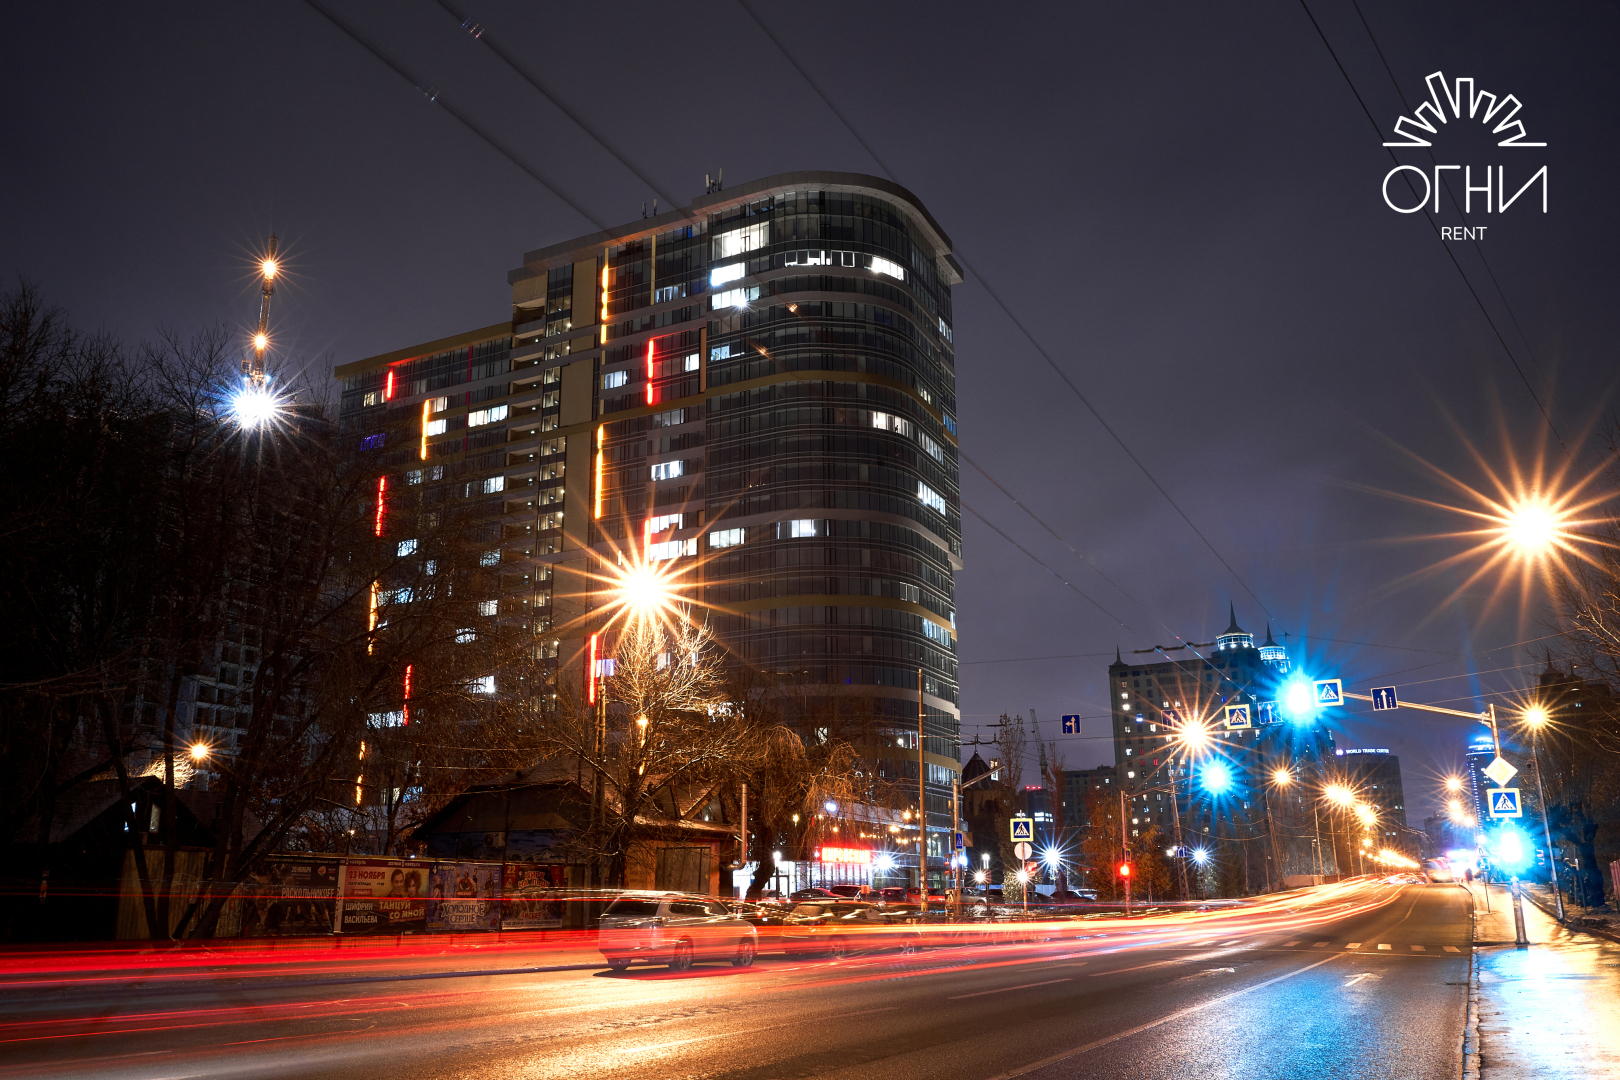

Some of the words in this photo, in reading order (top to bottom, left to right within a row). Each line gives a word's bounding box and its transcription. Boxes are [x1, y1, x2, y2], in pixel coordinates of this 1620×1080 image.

[506, 865, 516, 874] 22
[348, 871, 357, 879] 23
[358, 871, 385, 880] НОЯБРЯ
[524, 870, 546, 880] ЦИРК
[518, 879, 529, 889] НА
[531, 878, 551, 888] ЛЬДУ
[345, 902, 374, 911] ШИФРИН
[379, 899, 411, 911] ТАНЦУЙ
[441, 903, 485, 917] ХОЛОДНОЕ
[389, 911, 401, 920] СО
[401, 907, 425, 919] МНОЙ
[449, 913, 477, 924] СЕРДЦЕ
[344, 915, 378, 924] ВАСИЛЬЕВА
